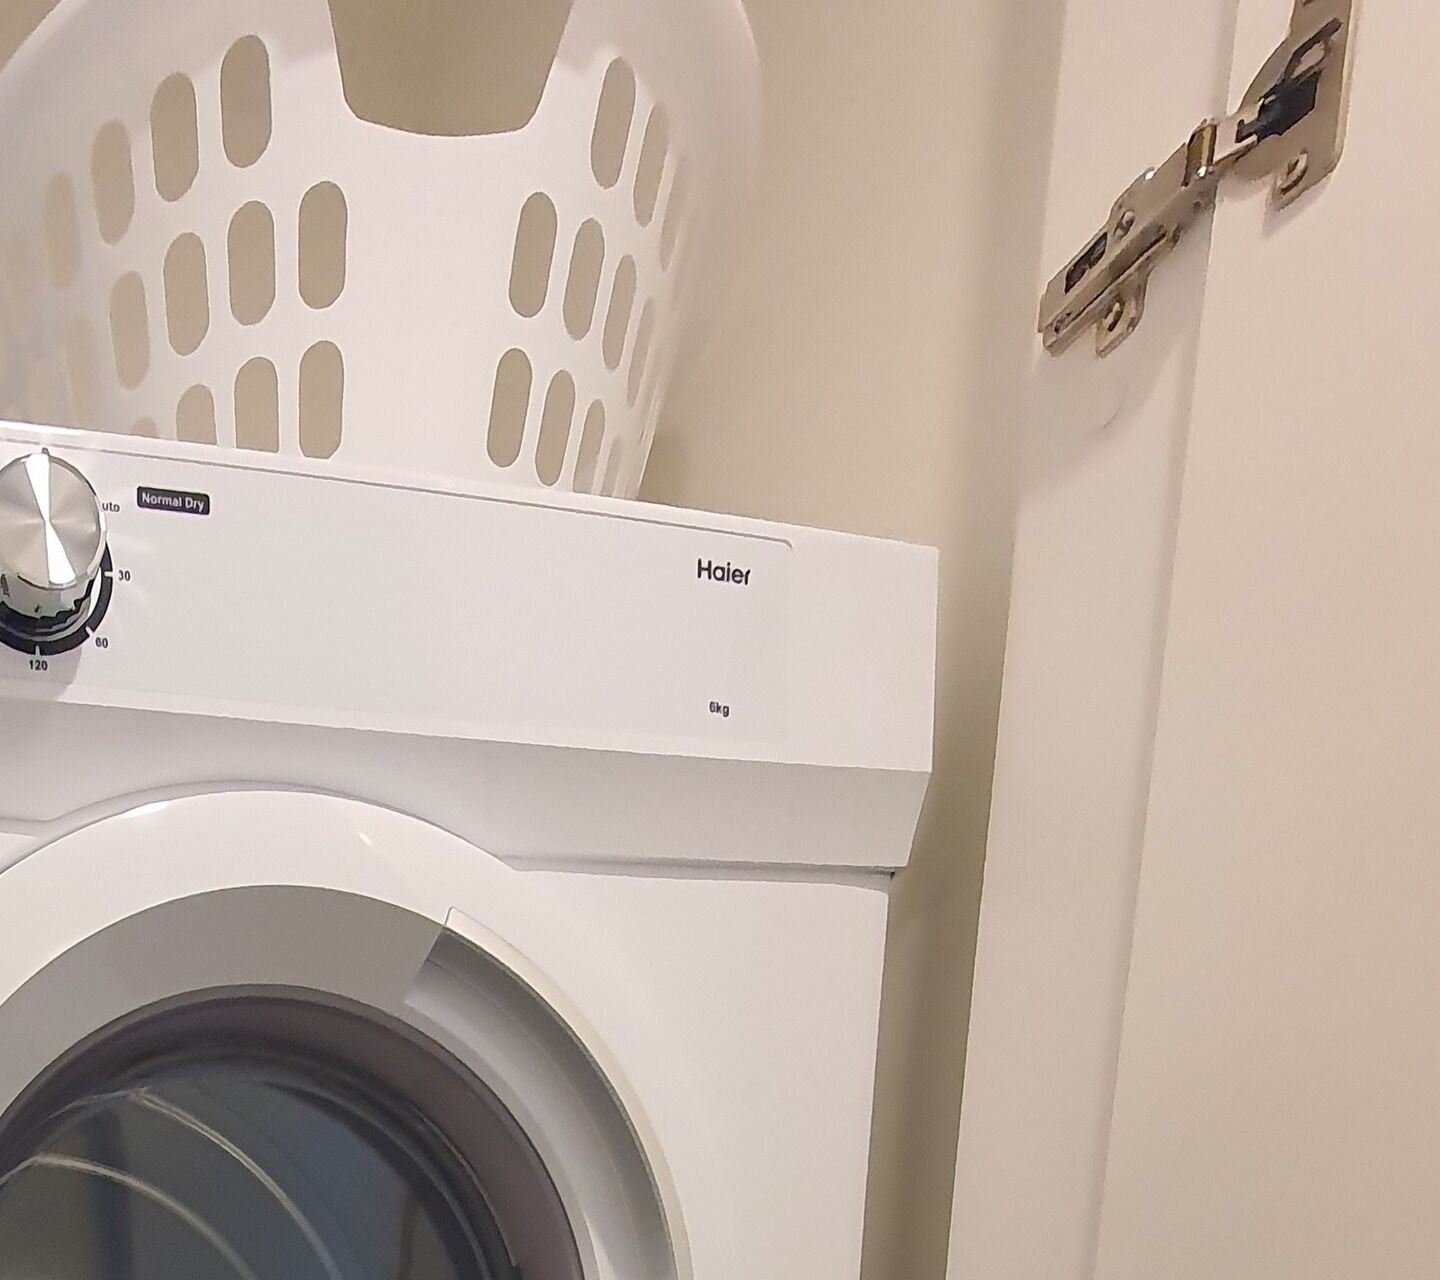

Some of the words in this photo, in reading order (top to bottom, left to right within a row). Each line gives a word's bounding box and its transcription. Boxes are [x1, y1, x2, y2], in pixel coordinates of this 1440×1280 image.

[101, 502, 121, 513] uto
[141, 493, 182, 508] Normal
[185, 497, 205, 513] Dry
[118, 569, 131, 582] 30
[696, 557, 752, 586] Haier
[95, 637, 109, 649] 60
[28, 659, 49, 671] 120
